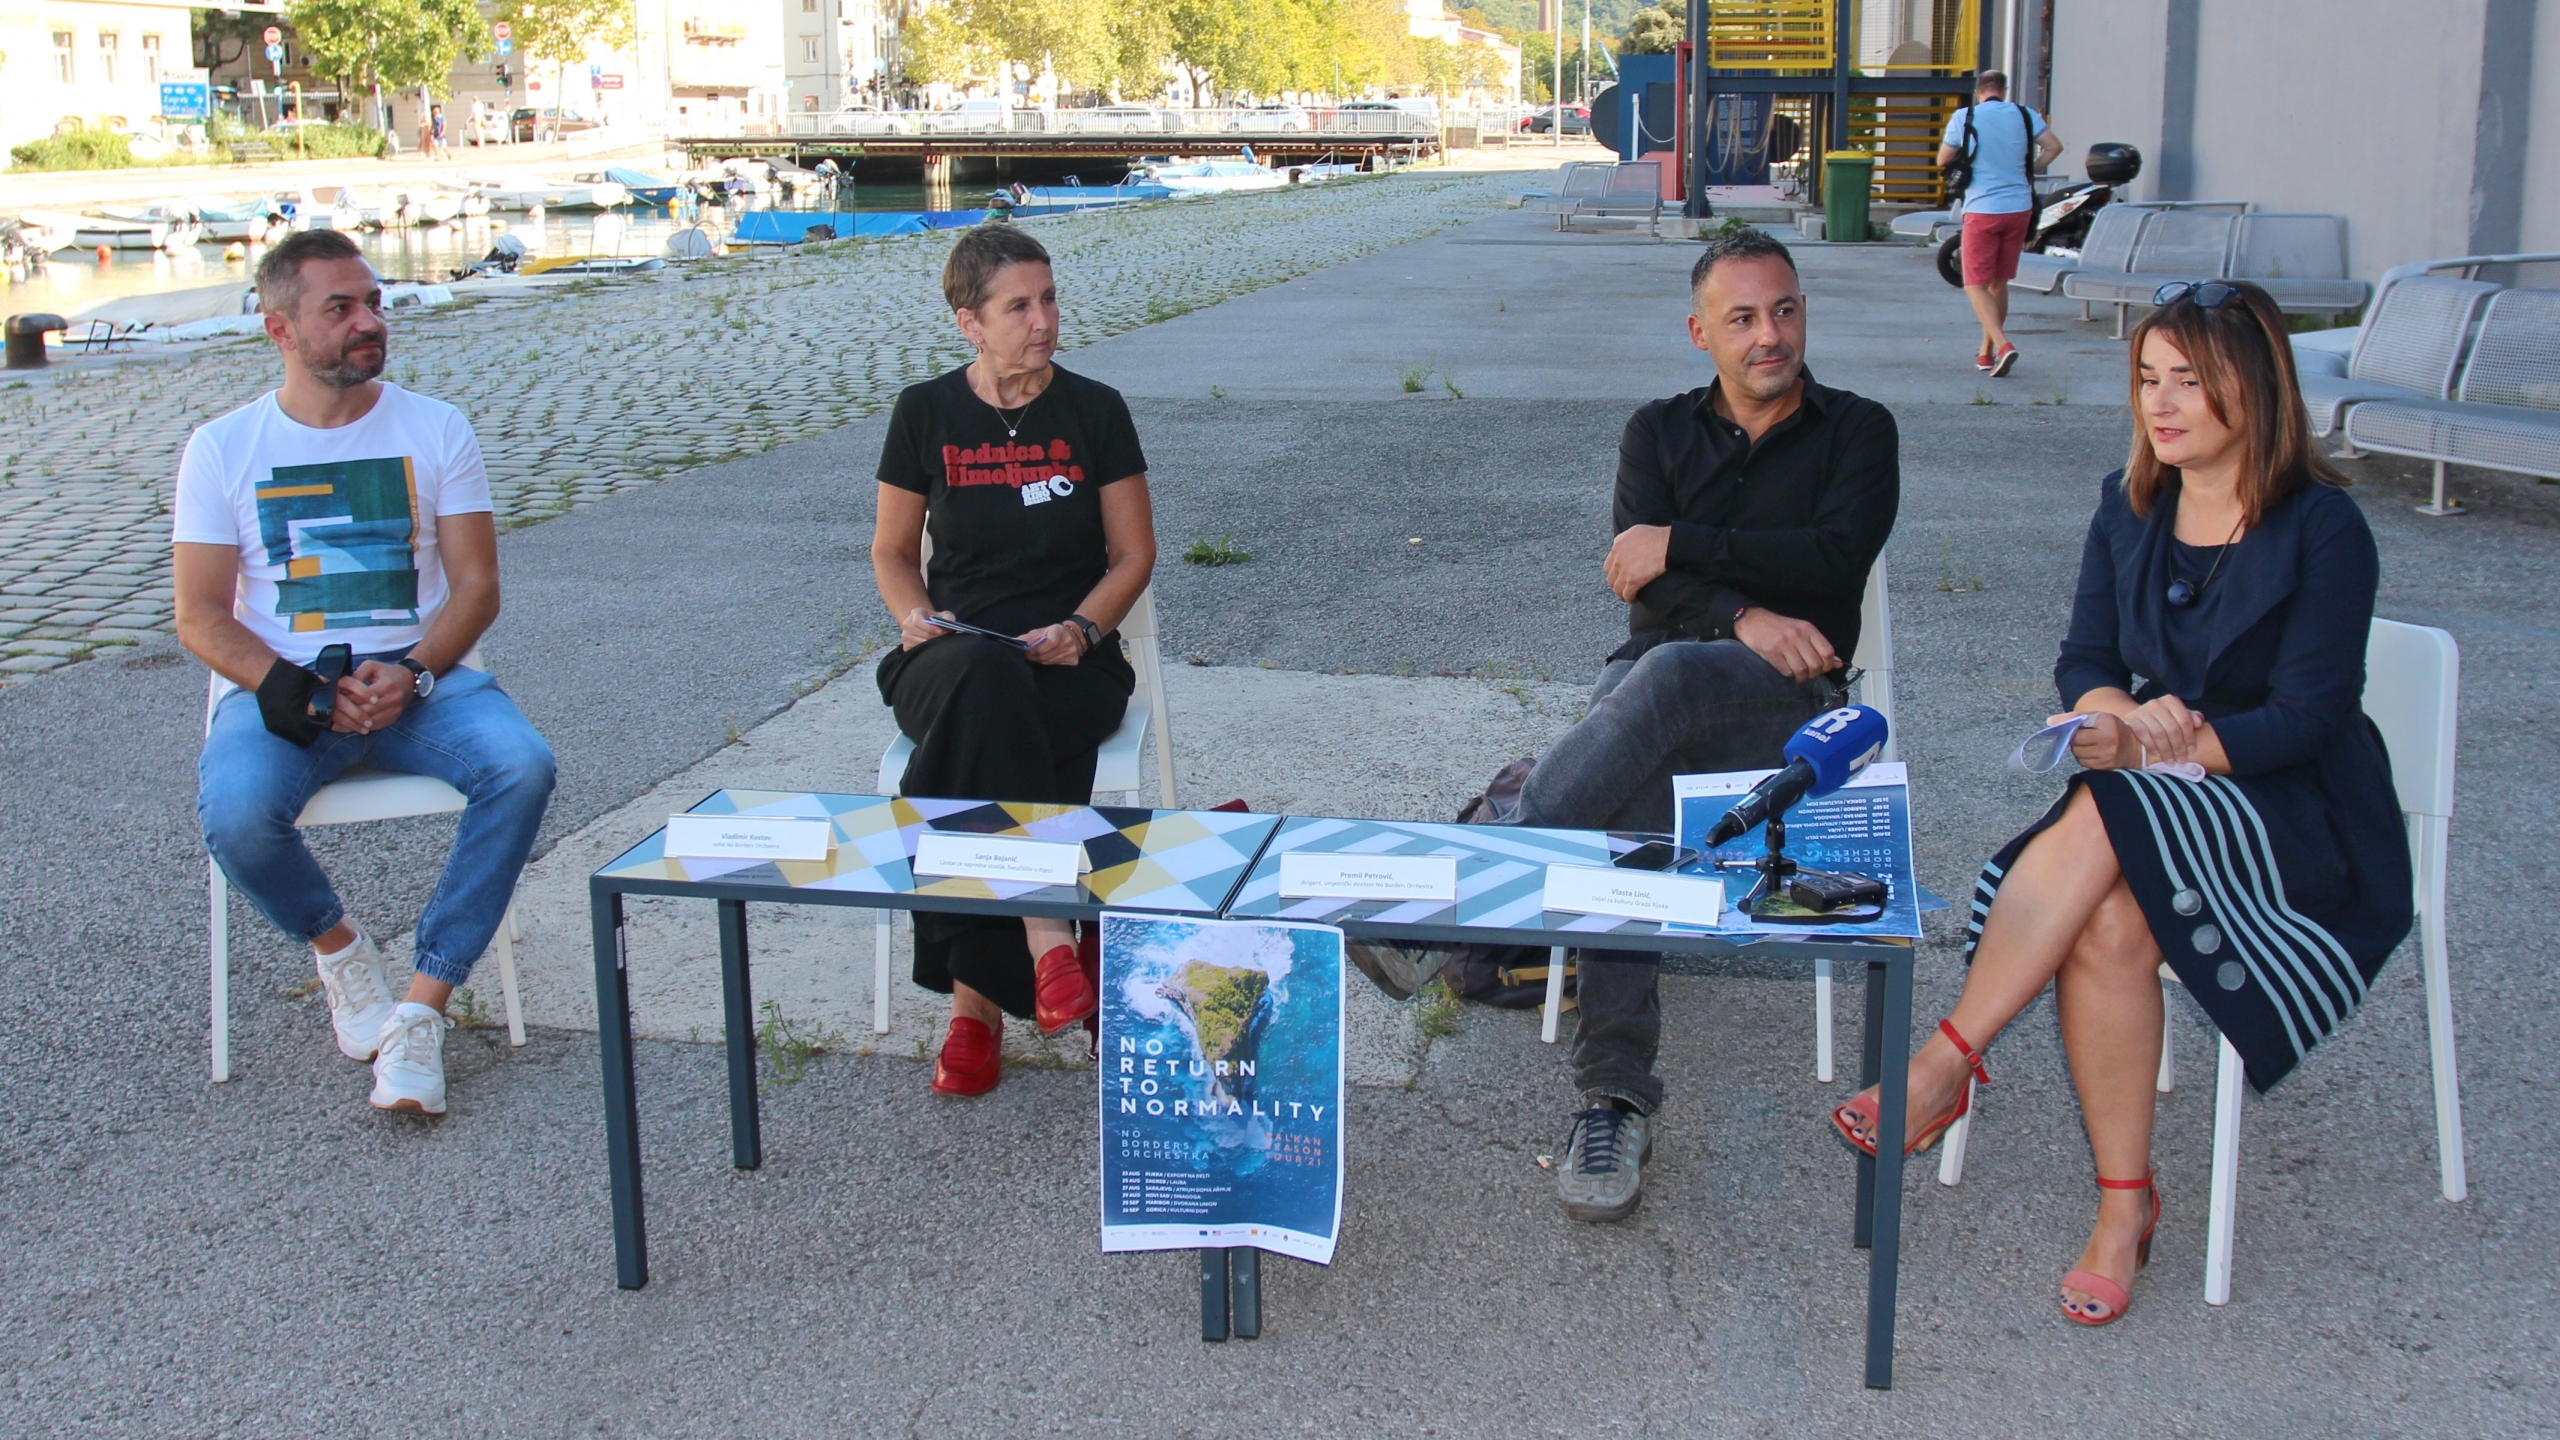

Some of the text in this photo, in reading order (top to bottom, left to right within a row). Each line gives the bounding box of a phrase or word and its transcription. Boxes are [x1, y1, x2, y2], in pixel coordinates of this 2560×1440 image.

[943, 441, 1044, 464] Radnica
[1021, 481, 1048, 495] ART
[1023, 489, 1050, 500] KINO
[1809, 707, 1861, 734] R
[1802, 728, 1831, 743] kanal
[721, 833, 748, 841] Vladimir
[975, 853, 992, 861] Sanja
[1806, 848, 1891, 856] ORCHESTRA
[1324, 880, 1352, 888] umjetnički
[1611, 888, 1632, 897] Vlasta
[1614, 898, 1634, 906] kulturu
[1652, 902, 1668, 910] Rijeka
[1120, 1037, 1163, 1056] NO
[1120, 1058, 1256, 1077] RETURN
[1120, 1077, 1158, 1096] TO
[1120, 1098, 1324, 1122] NORMALITY
[1121, 1130, 1141, 1138] NO
[1265, 1132, 1321, 1146] BALKAN
[1122, 1140, 1189, 1150] BORDERS
[1122, 1150, 1210, 1160] ORCHESTRA
